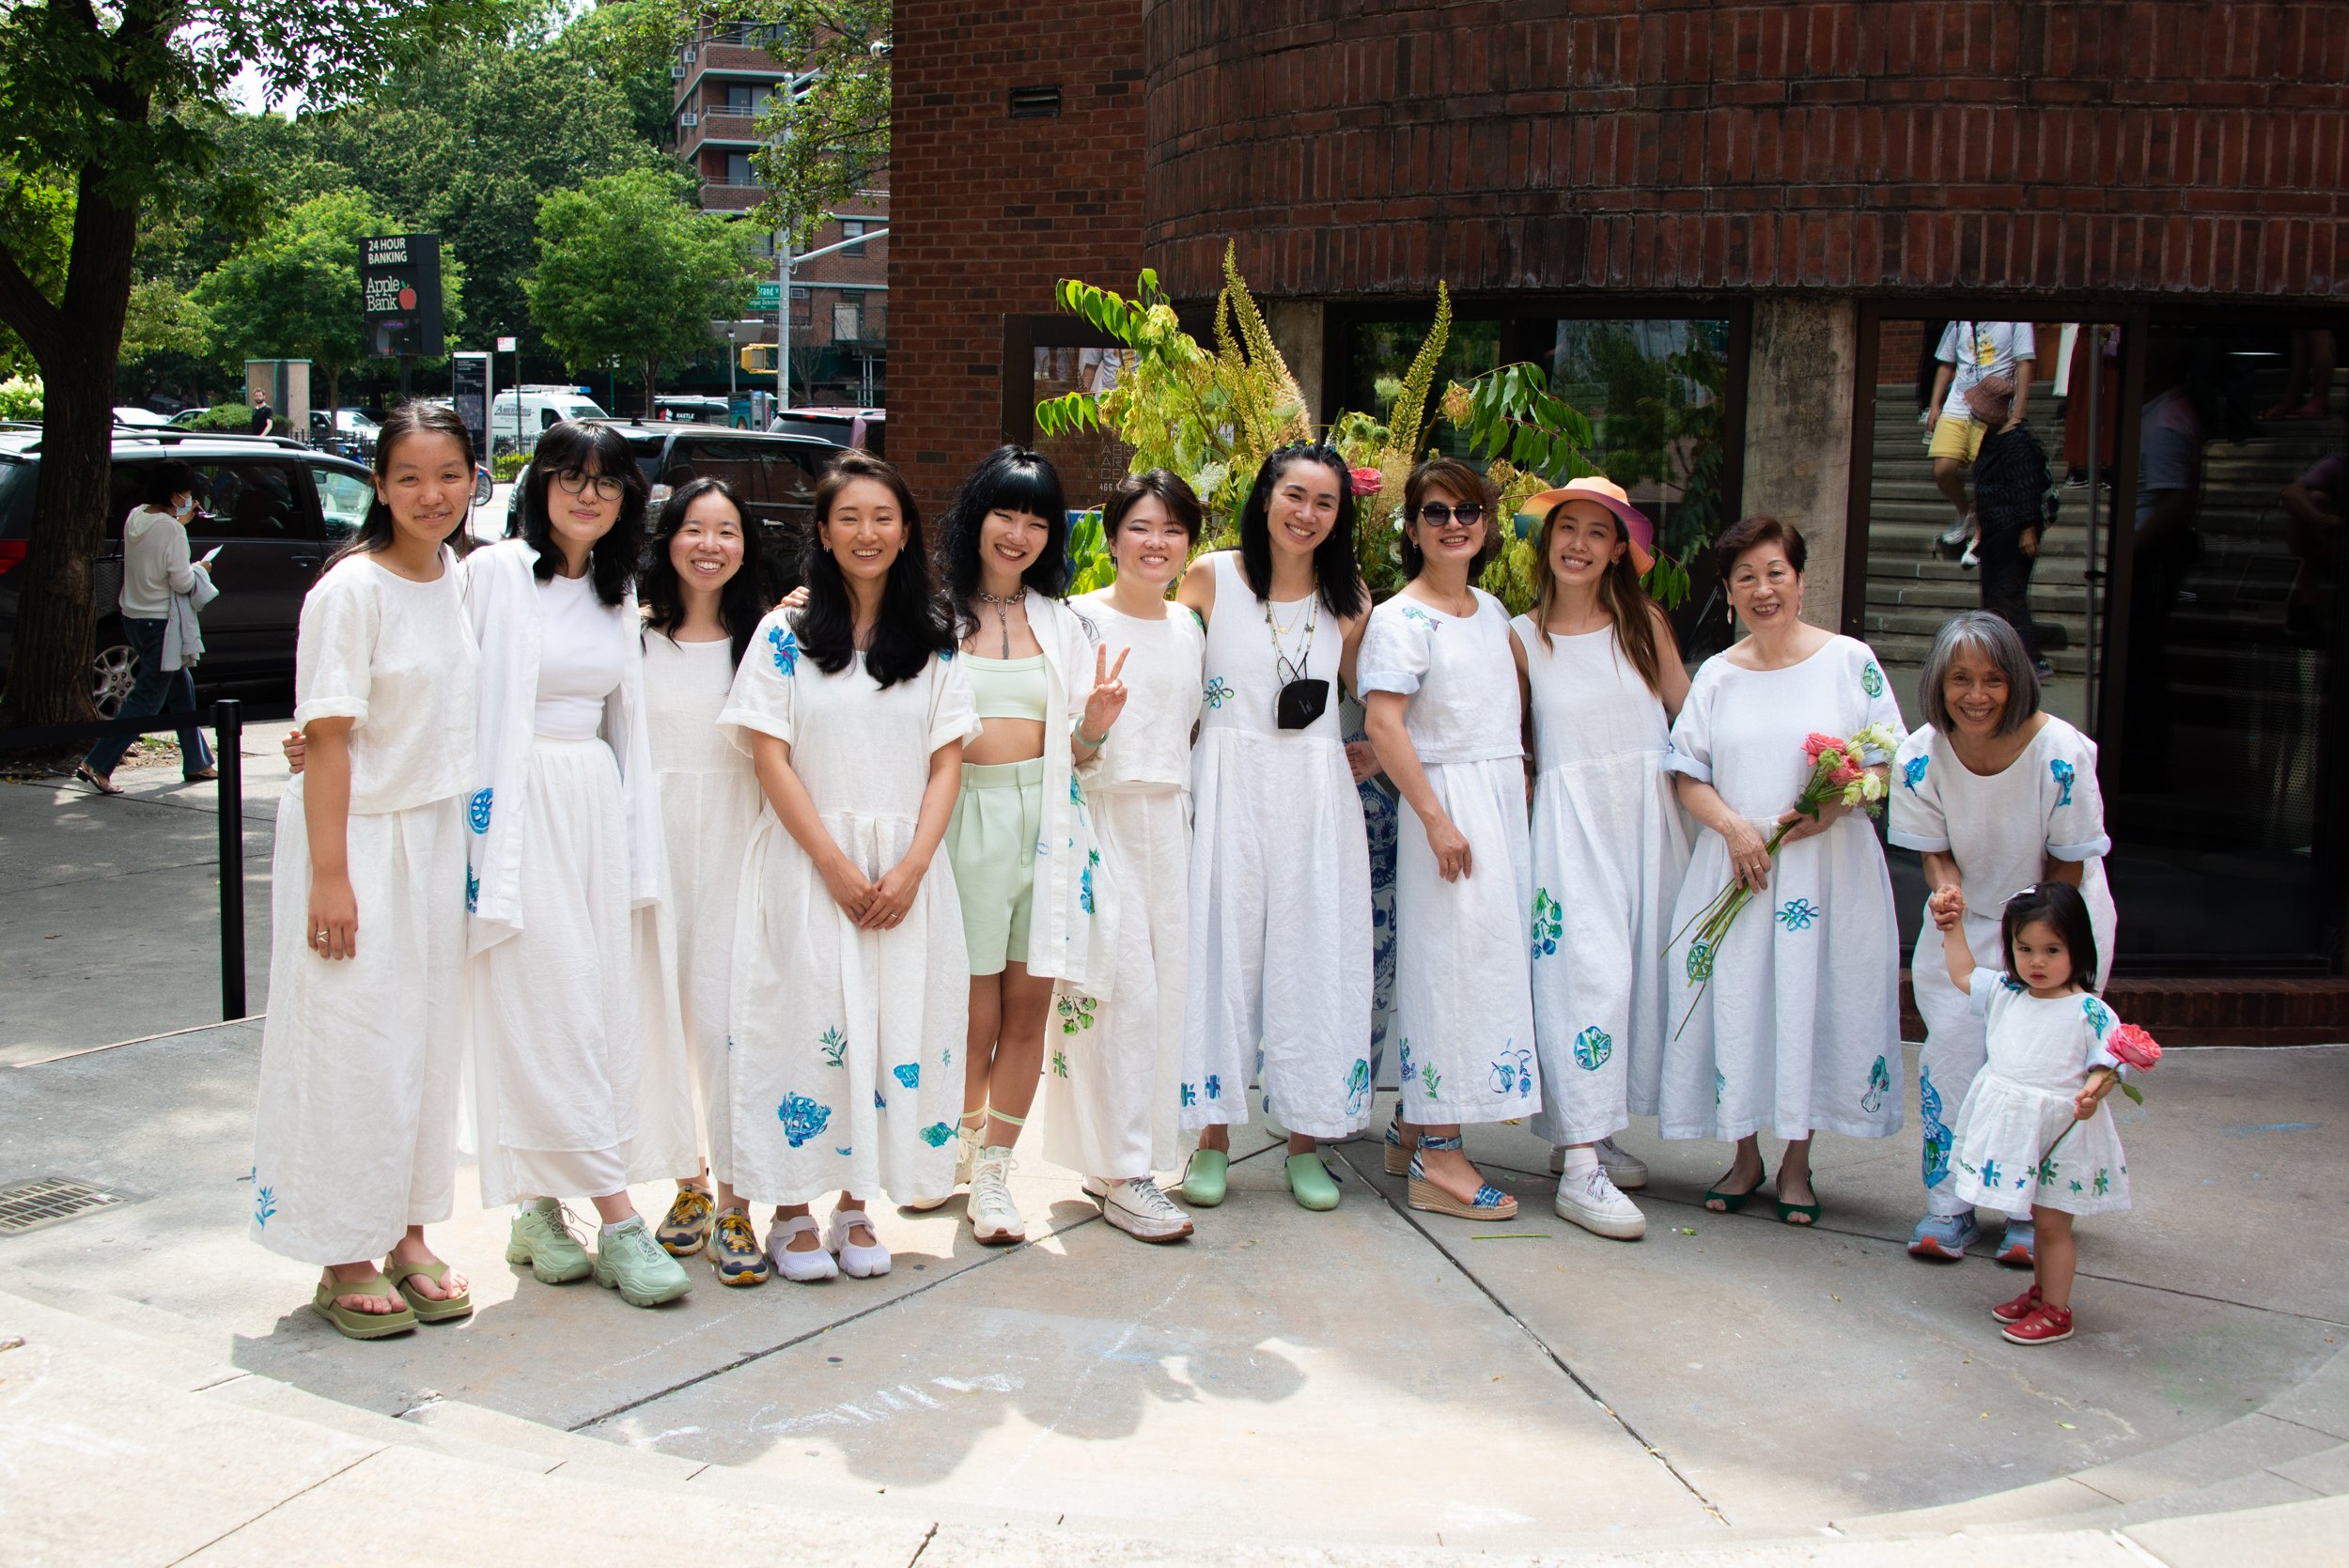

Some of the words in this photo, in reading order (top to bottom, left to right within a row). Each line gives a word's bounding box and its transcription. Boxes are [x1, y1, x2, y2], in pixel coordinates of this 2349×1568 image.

[368, 240, 379, 252] 24
[380, 237, 406, 250] HOUR
[367, 250, 408, 265] BANKING
[366, 275, 400, 297] Apple
[366, 294, 398, 312] Bank
[1099, 483, 1112, 491] 466
